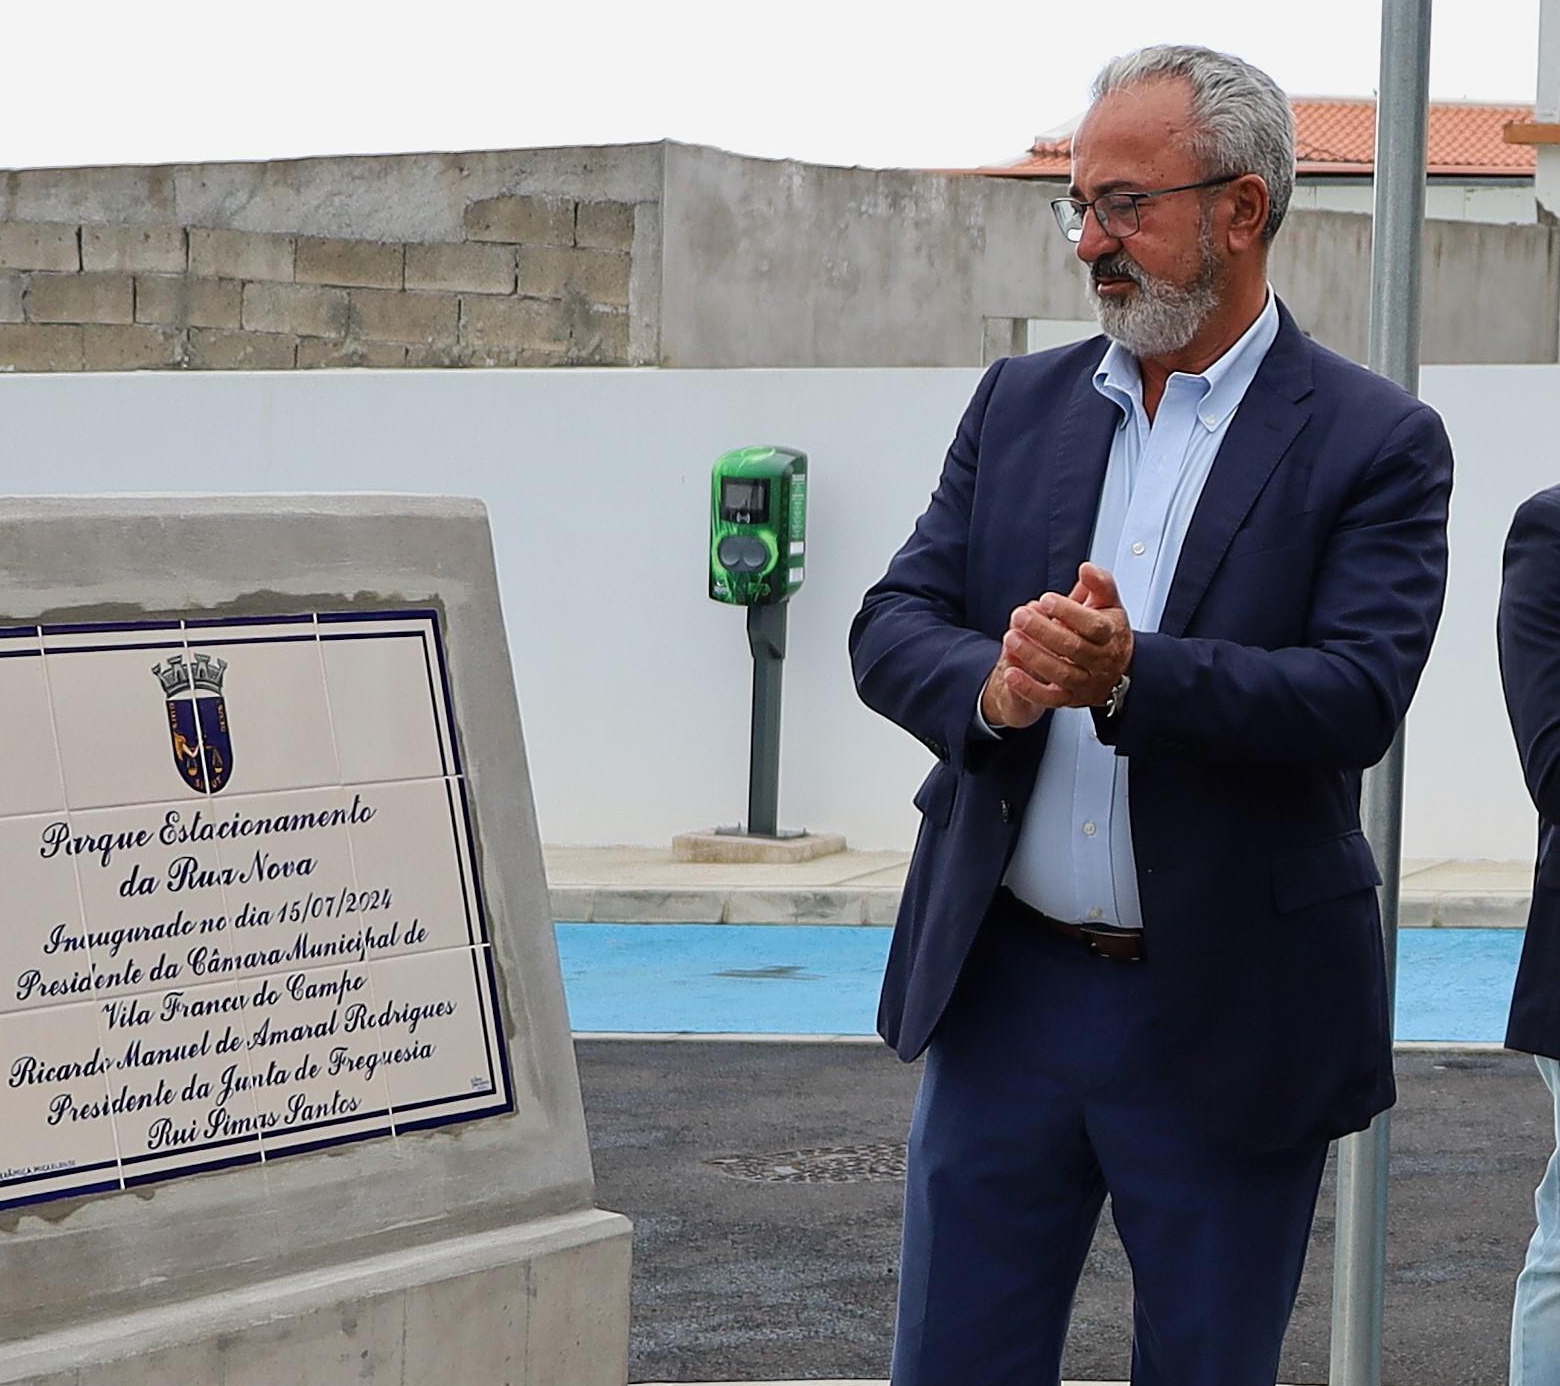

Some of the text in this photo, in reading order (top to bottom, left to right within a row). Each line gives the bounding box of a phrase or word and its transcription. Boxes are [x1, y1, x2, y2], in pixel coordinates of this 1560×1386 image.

[40, 794, 377, 867] Parque Estacionamento
[119, 849, 318, 897] da Rua Nova
[43, 887, 392, 957] Inaugurado no dia 15/07/2024
[16, 918, 429, 1000] Presidente da Câmara Municipal de
[101, 969, 368, 1030] Vila Franca do Campo
[8, 1000, 457, 1087] Ricardo Manuel de Amaral Rodrigues
[47, 1040, 436, 1125] Presidente da Junta de Freguesia
[147, 1089, 362, 1149] Rui Simas Santos
